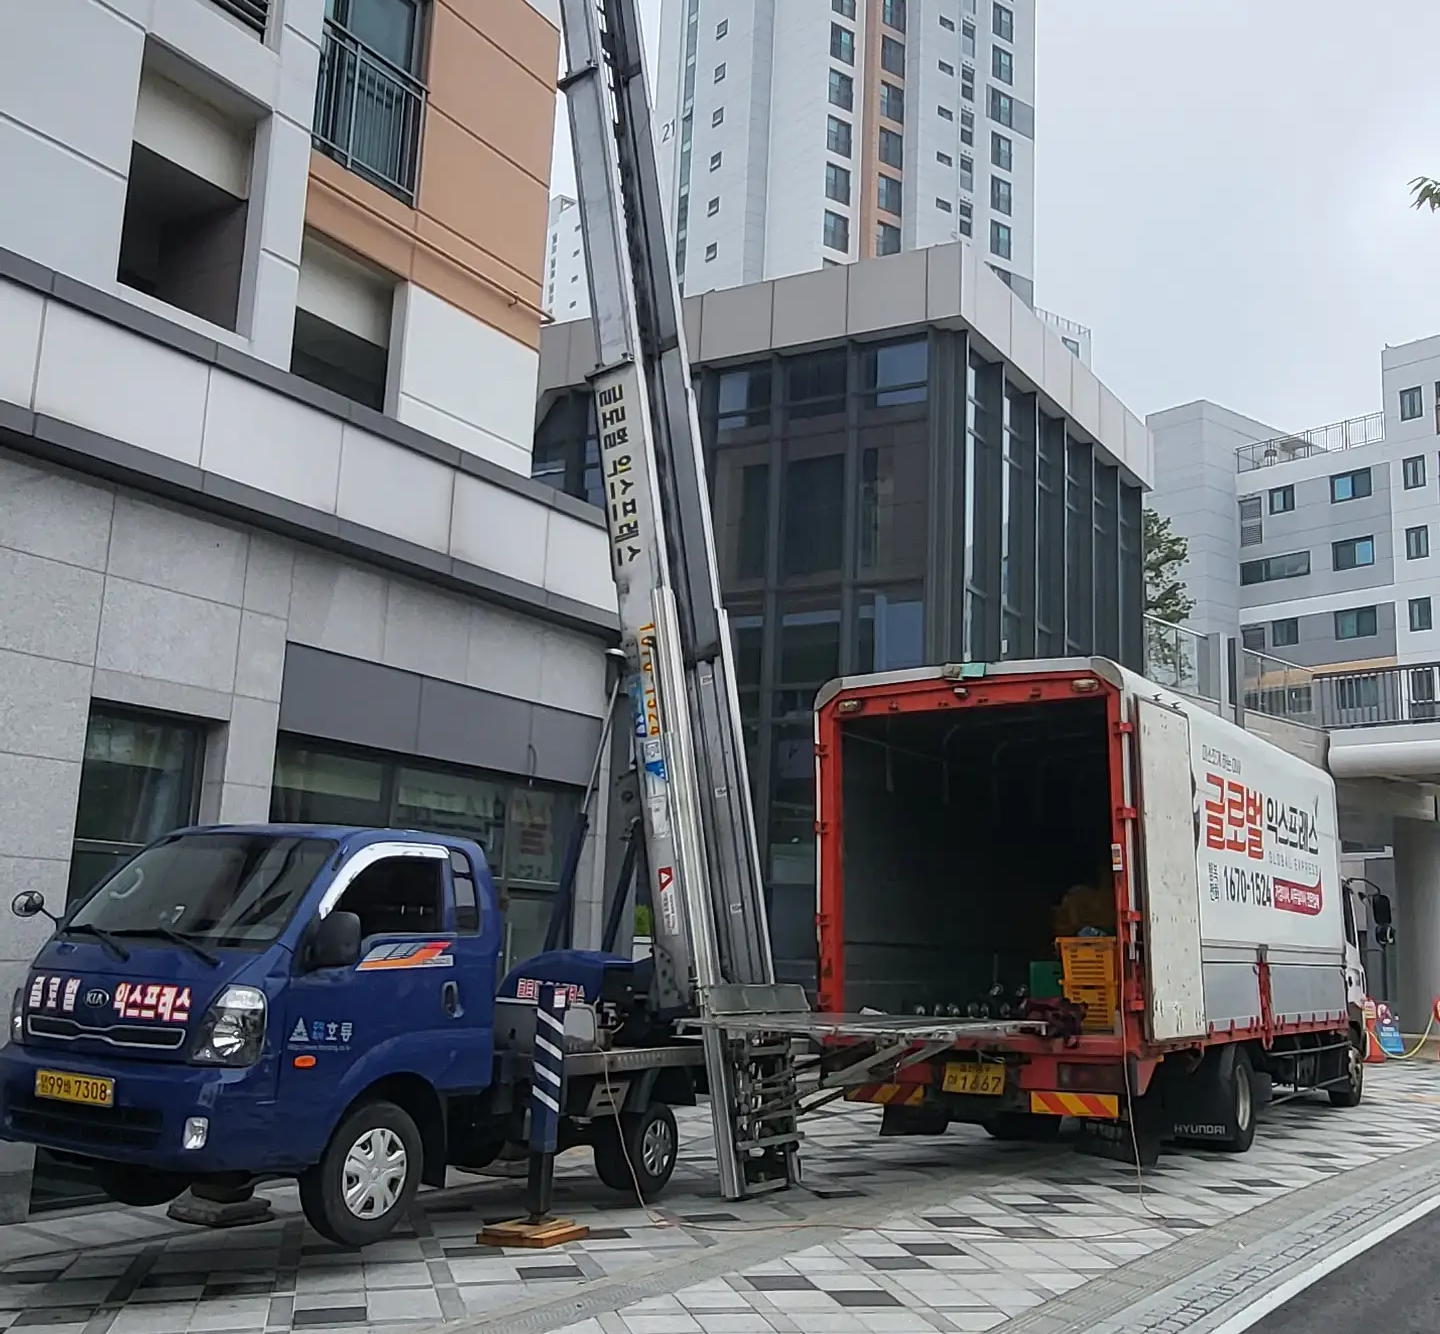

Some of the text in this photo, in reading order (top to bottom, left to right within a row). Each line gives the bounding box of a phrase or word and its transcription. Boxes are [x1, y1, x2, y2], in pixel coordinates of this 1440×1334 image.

[599, 383, 641, 566] 글로벌 익스프레스
[1205, 772, 1319, 860] 글로벌 익스프레스
[1223, 865, 1272, 907] 1670-1524
[28, 976, 81, 1012] 글로벌
[85, 991, 105, 1006] KIA
[113, 982, 191, 1023] 익스프레스
[325, 1021, 353, 1043] 호룡
[74, 1079, 108, 1101] 7308
[1174, 1123, 1226, 1135] HYUNDAI
